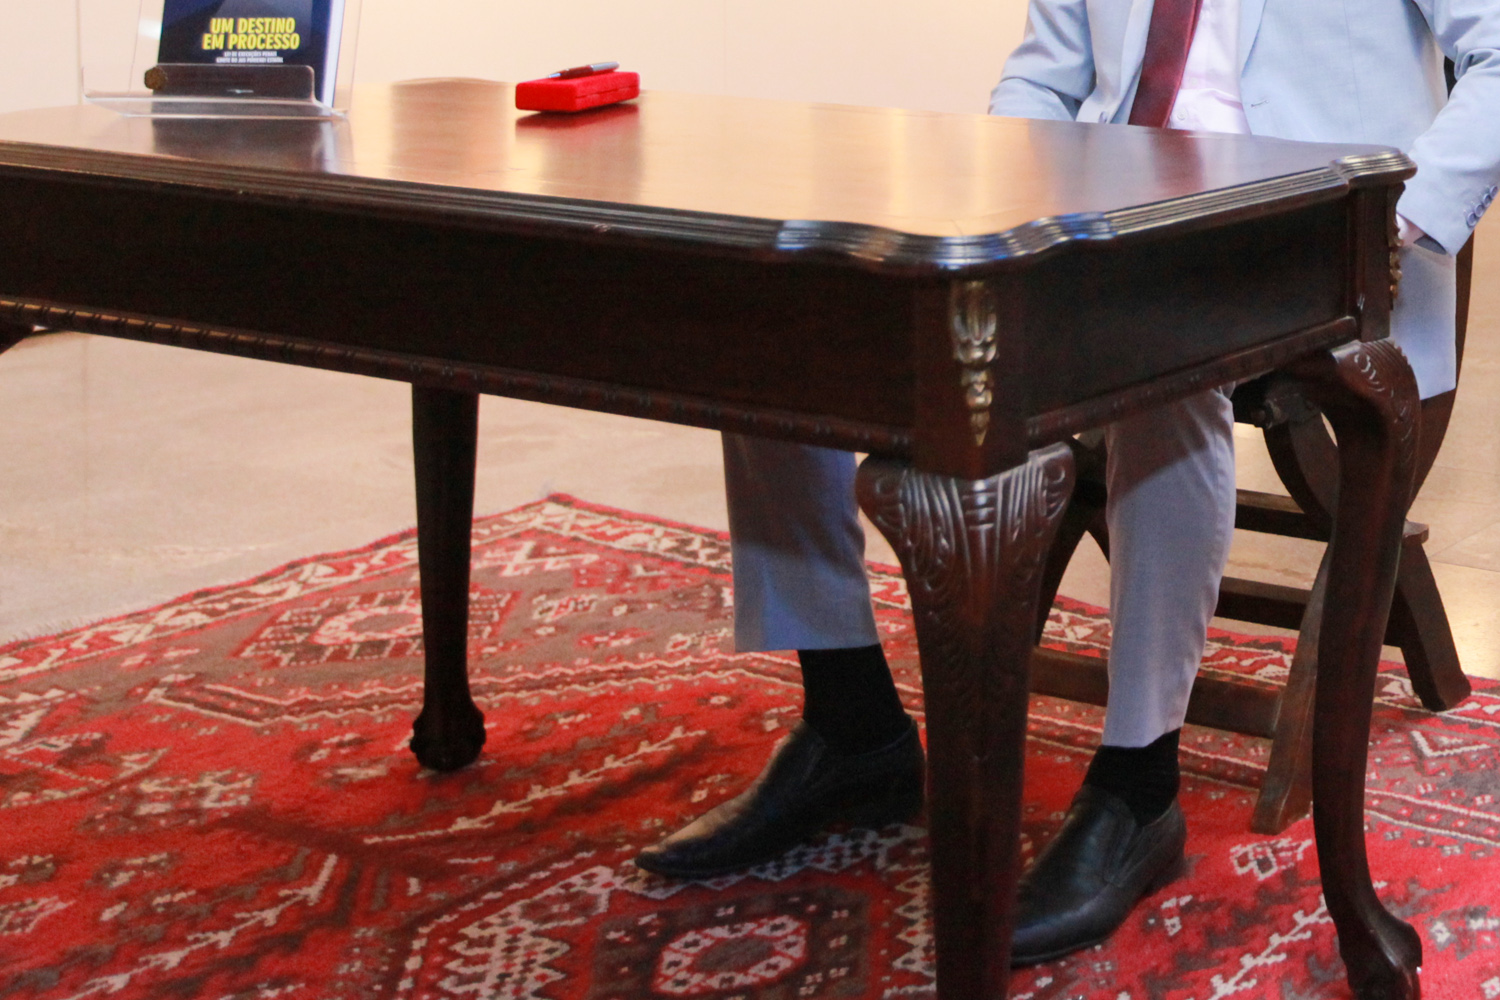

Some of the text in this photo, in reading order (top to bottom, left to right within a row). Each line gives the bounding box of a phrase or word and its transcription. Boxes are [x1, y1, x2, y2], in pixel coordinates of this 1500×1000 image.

[210, 17, 296, 34] UM DESTINO
[202, 33, 300, 50] EM PROCESSO
